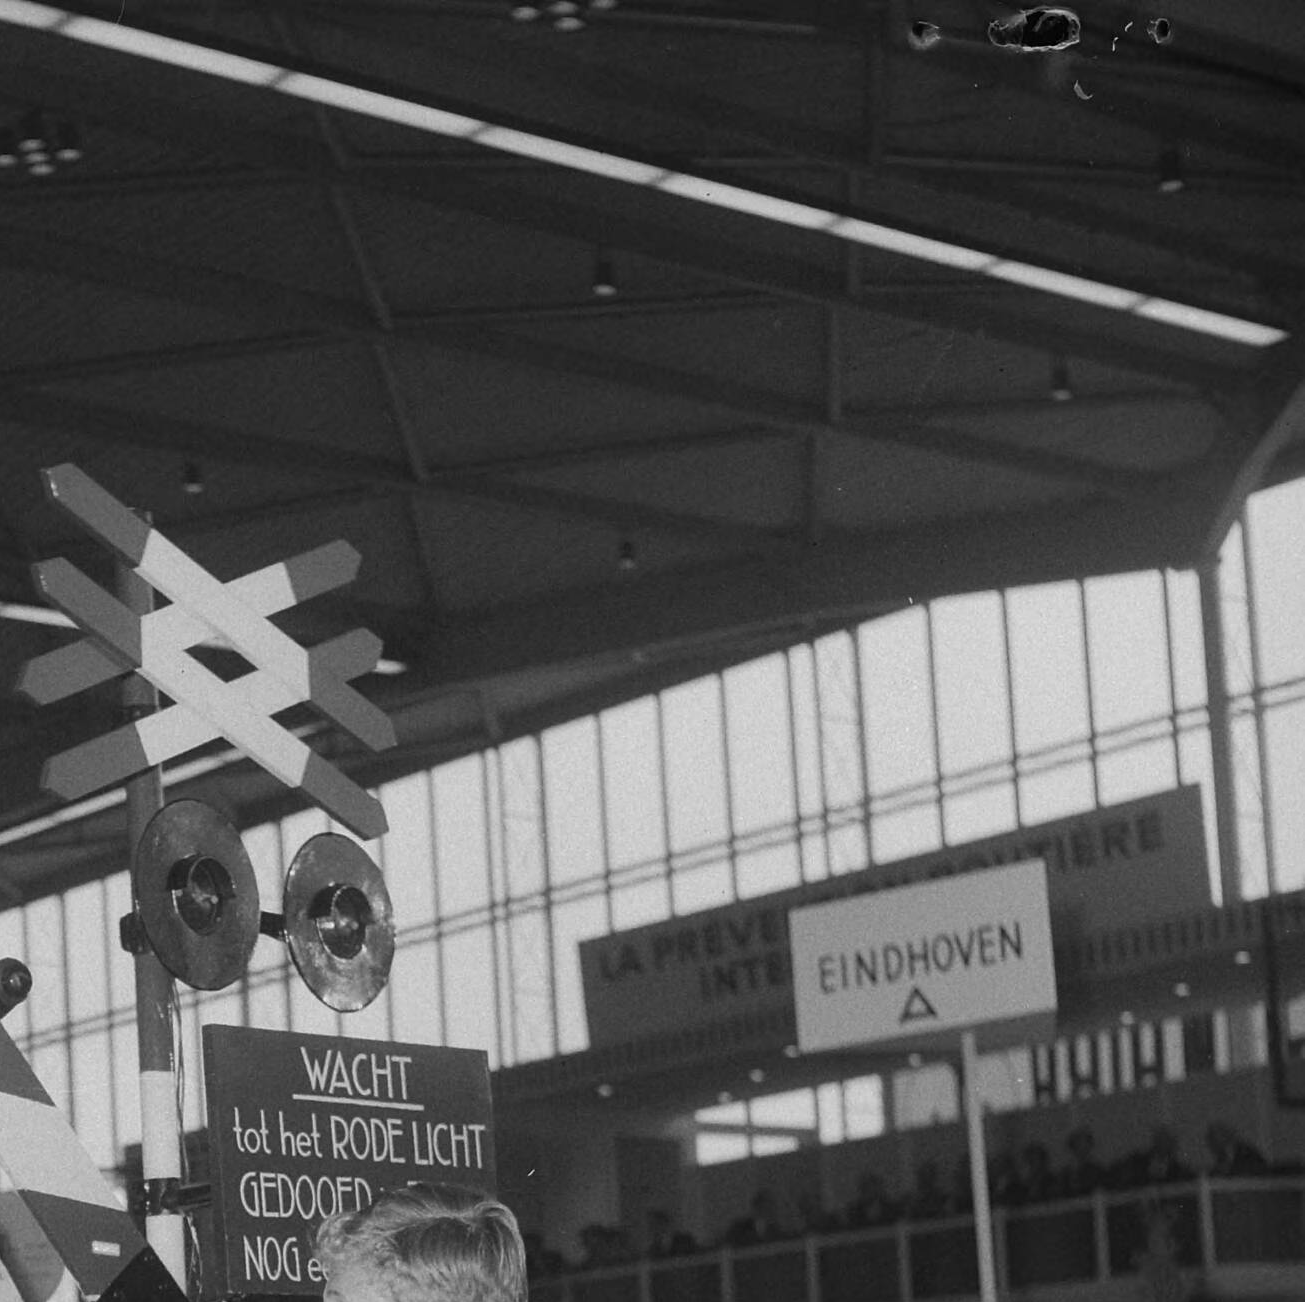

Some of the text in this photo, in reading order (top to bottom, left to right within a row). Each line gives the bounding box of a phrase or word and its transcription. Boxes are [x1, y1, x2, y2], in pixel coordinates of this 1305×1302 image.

[817, 922, 1023, 994] EINDHOVEN
[300, 1046, 412, 1100] WACHT
[233, 1106, 486, 1169] tot het RODE LICHT
[243, 1236, 301, 1282] NOG
